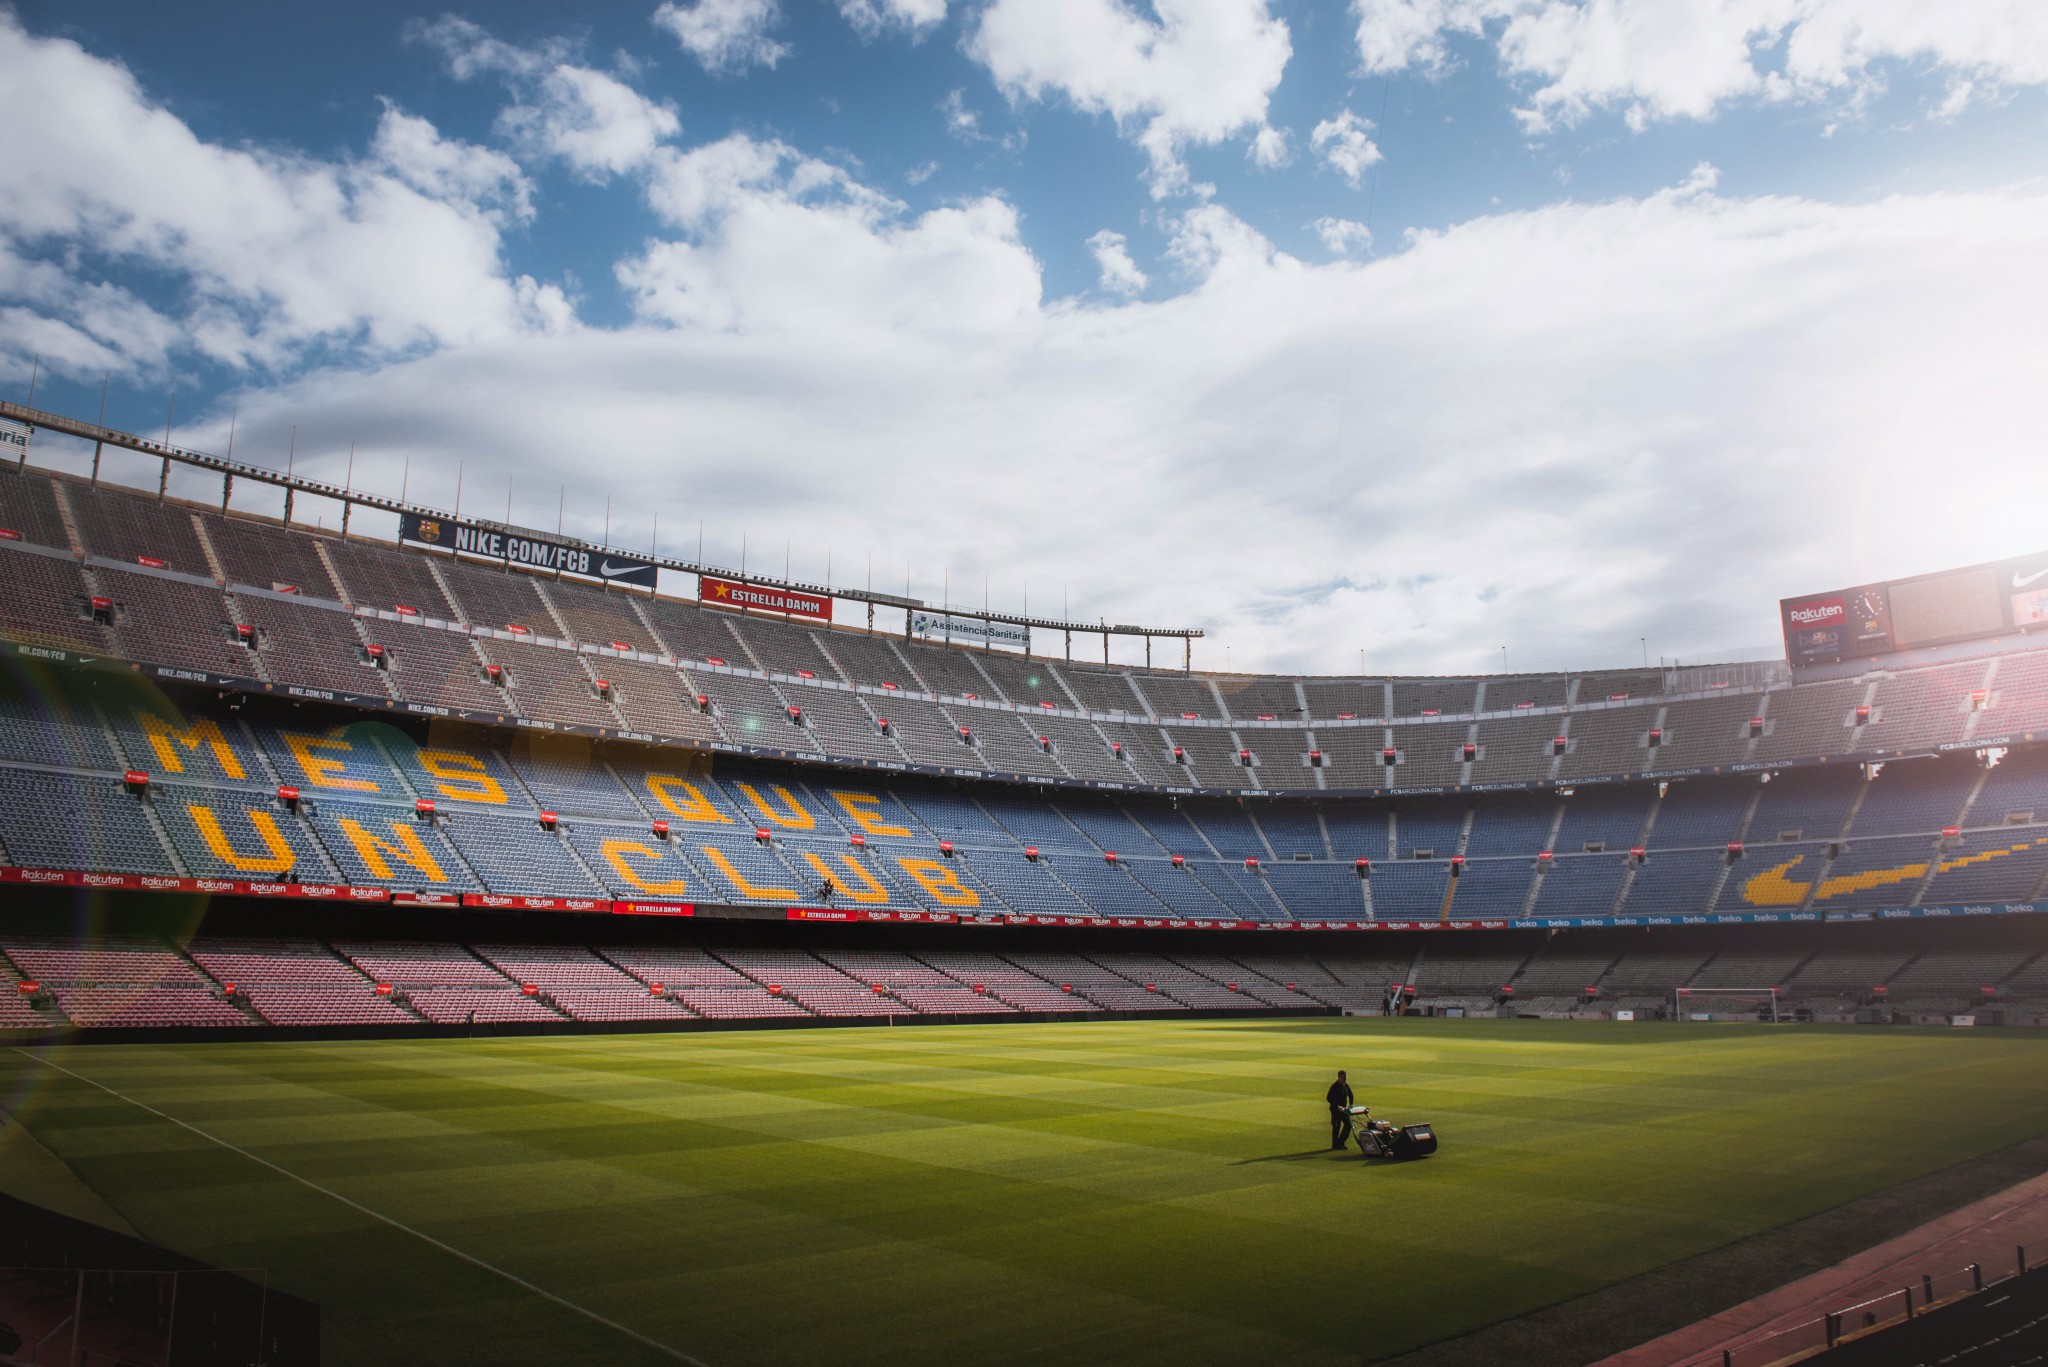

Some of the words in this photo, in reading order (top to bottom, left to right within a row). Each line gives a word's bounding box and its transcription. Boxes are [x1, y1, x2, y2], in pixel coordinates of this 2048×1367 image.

[0, 430, 26, 446] ria
[455, 527, 590, 573] NIKE.COM/FCB
[731, 589, 784, 608] ESTRELLA
[786, 598, 820, 613] DAMM
[1791, 605, 1843, 623] Rakuten
[158, 667, 206, 682] NIKE.COM/FCB
[288, 686, 334, 700] NIKE.COM/FCB
[646, 774, 913, 838] QUE
[188, 805, 449, 882] UN
[602, 840, 980, 906] CLUB
[22, 870, 64, 882] Rakuten
[83, 874, 124, 885] Rakuten
[141, 877, 180, 888] Rakuten
[196, 880, 234, 890] Rakuten
[250, 883, 286, 893] Rakuten
[302, 886, 336, 896] Rakuten
[350, 888, 384, 898] Rakuten
[416, 894, 440, 902] Rakuten
[482, 896, 512, 905] Rakuten
[525, 898, 554, 907] Rakuten
[566, 900, 594, 909] Rakuten
[636, 905, 662, 913] ESTRELLA
[2005, 904, 2034, 912] beko
[1884, 909, 1910, 917] beko
[1923, 908, 1950, 916] beko
[1964, 906, 1991, 914] beko
